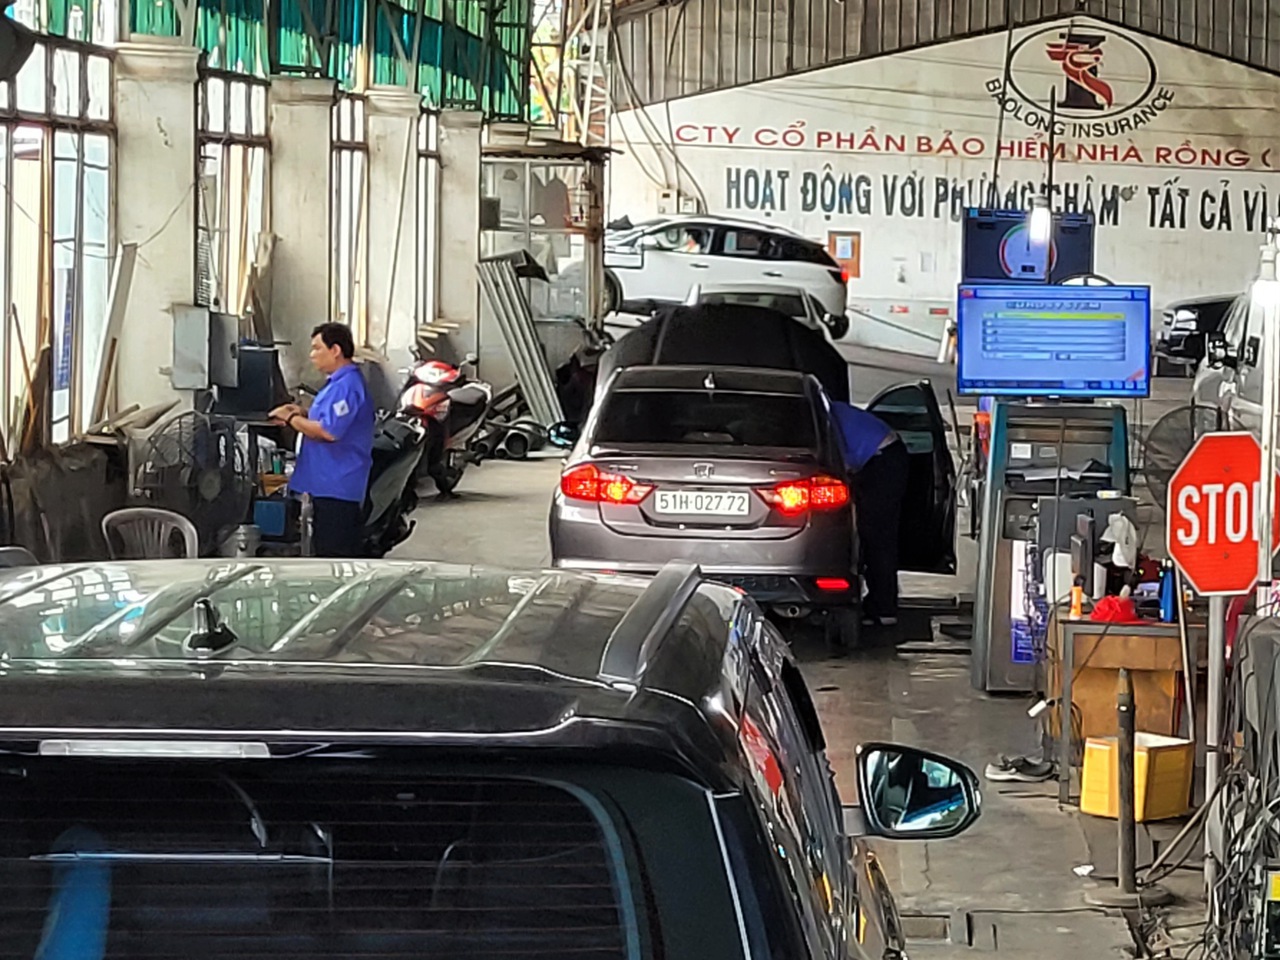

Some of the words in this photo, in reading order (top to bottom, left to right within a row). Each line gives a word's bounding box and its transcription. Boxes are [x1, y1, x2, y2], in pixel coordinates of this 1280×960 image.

[1073, 87, 1175, 138] INSURANCE
[675, 124, 741, 145] CTY
[754, 120, 806, 147] CỔ
[816, 126, 906, 153] PHẦN
[917, 130, 985, 156] BẢO
[999, 133, 1066, 161] HIỂM
[1077, 139, 1144, 164] NHÀ
[1156, 140, 1251, 167] RỒNG
[726, 167, 789, 217] HOẠT
[800, 163, 872, 224] ĐỘNG
[1148, 176, 1191, 230] TẤT
[1201, 179, 1233, 232] CẢ
